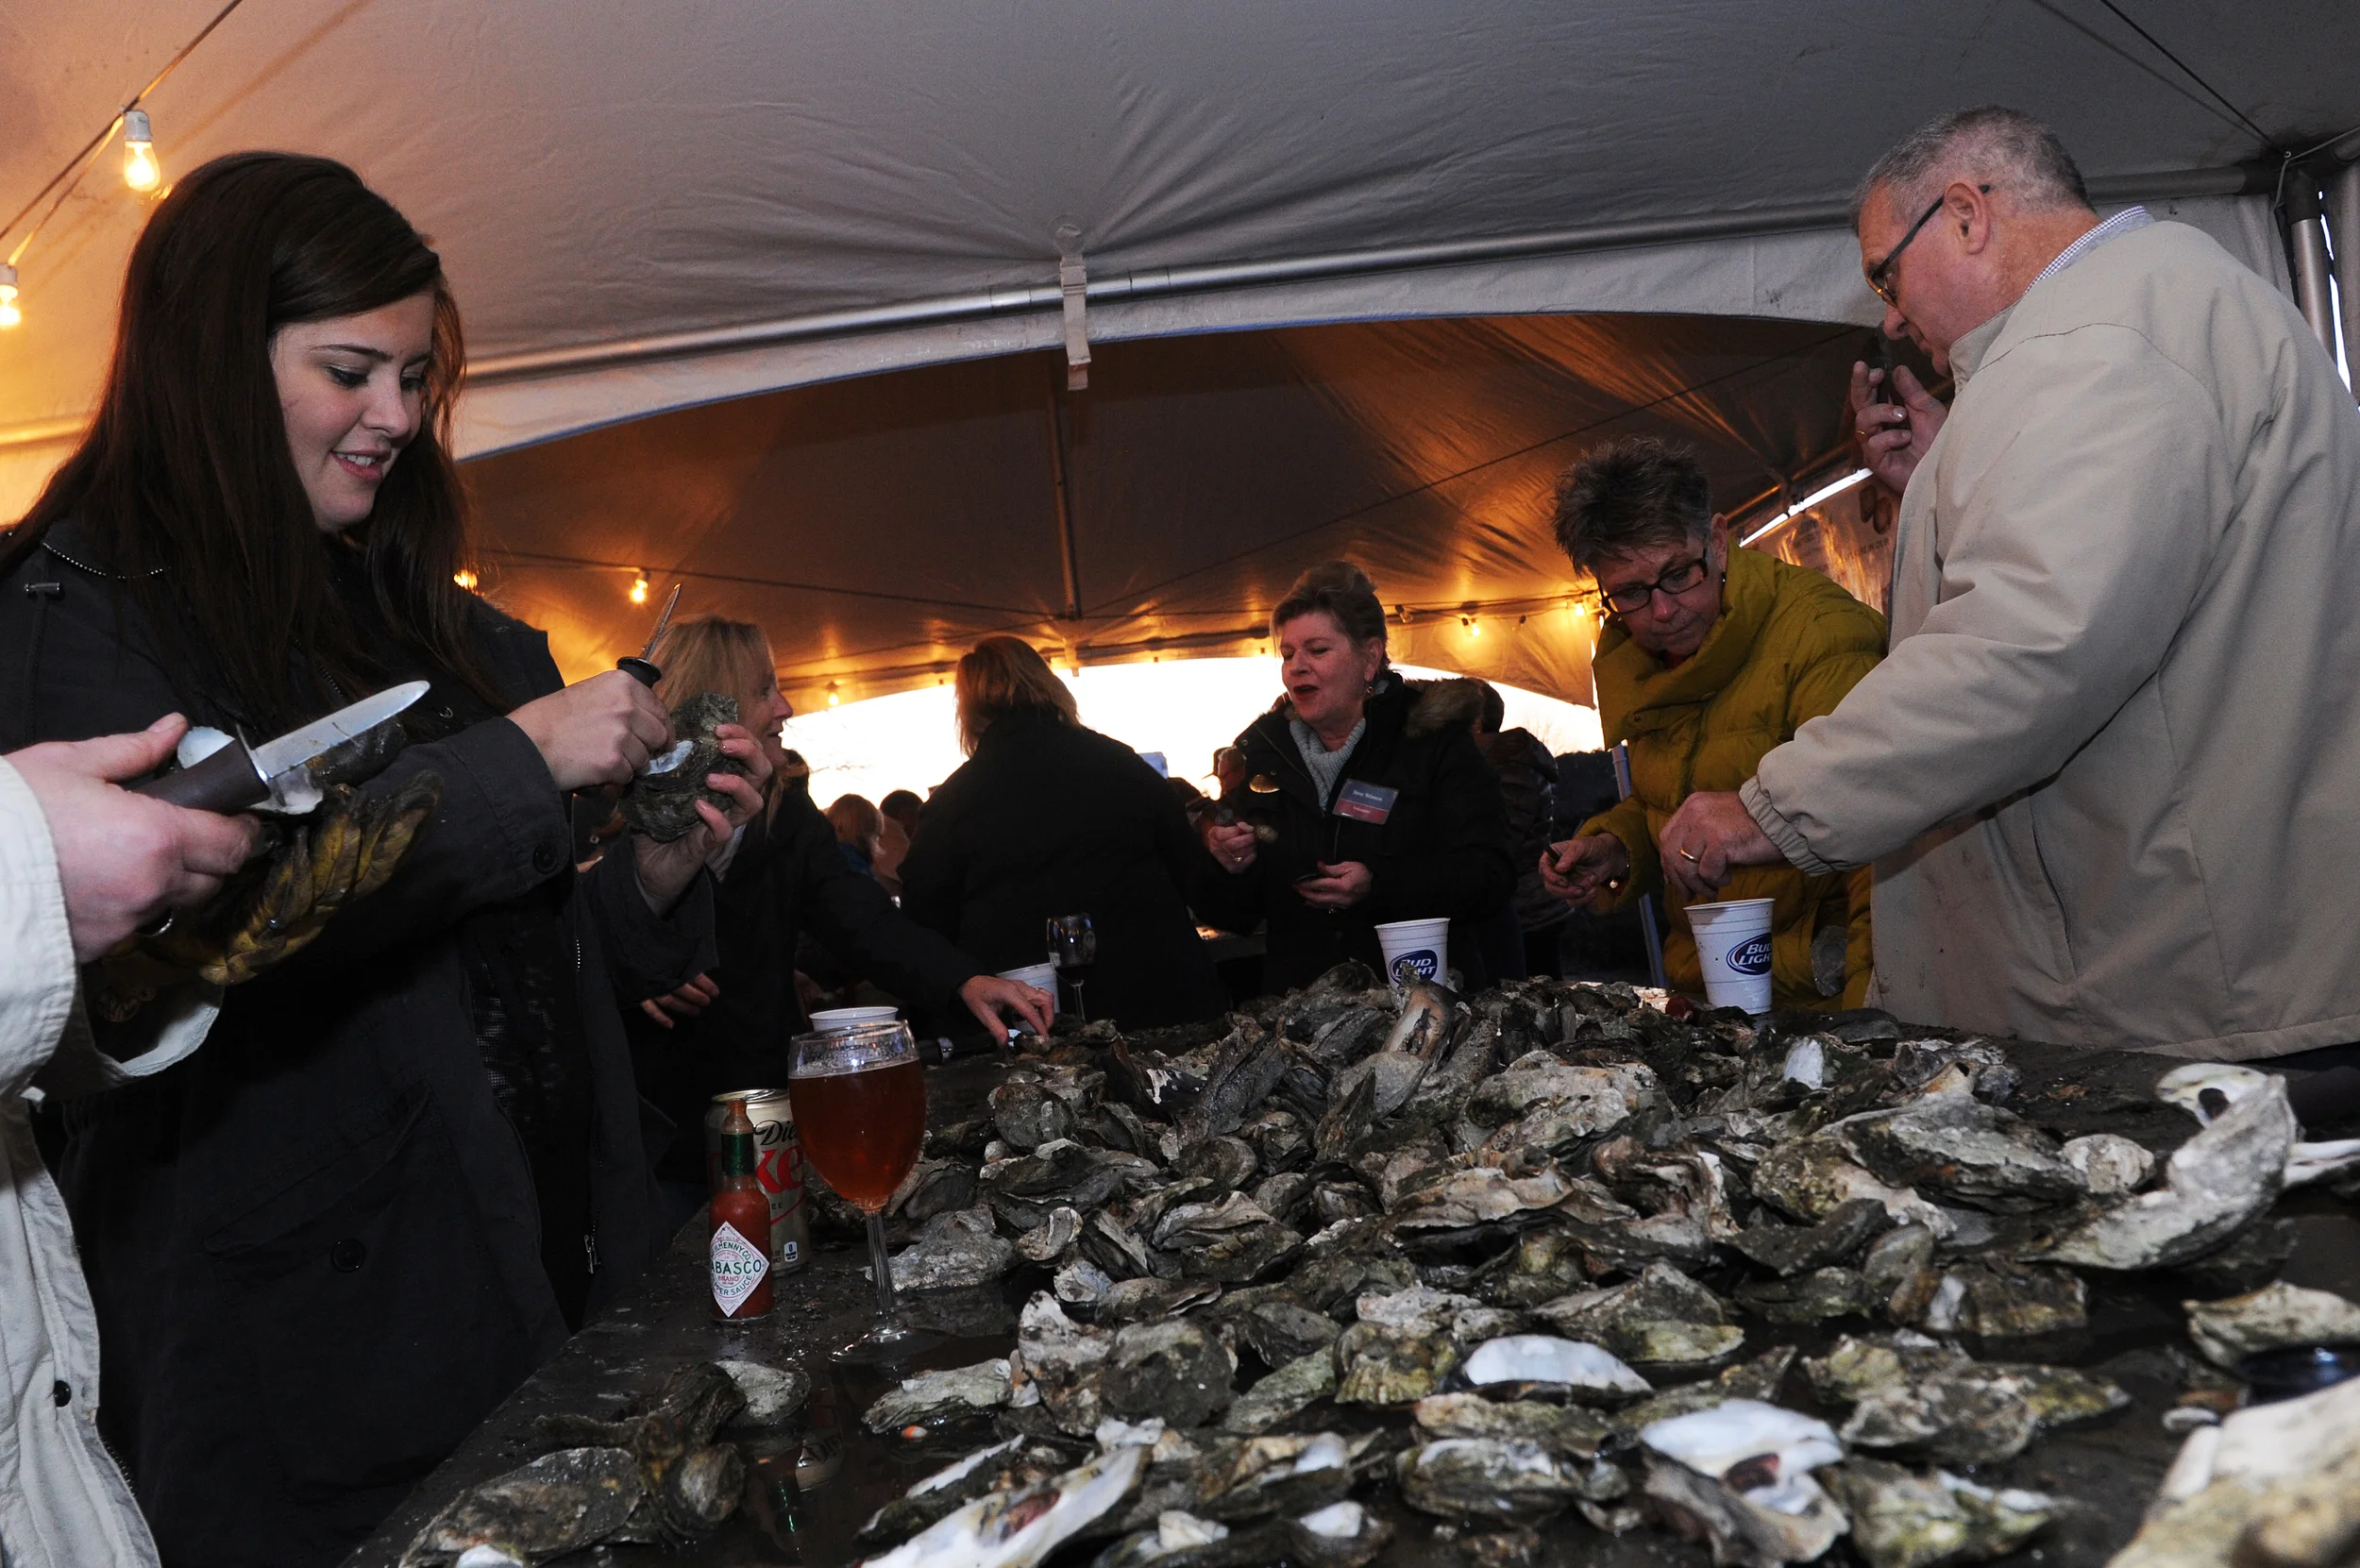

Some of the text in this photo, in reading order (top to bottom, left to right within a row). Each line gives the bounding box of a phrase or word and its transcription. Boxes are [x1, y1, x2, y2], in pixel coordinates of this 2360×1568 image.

[1738, 953, 1773, 966] LIGH
[1395, 966, 1436, 977] LHT
[753, 1120, 797, 1146] Die
[711, 1259, 762, 1274] ABASCO
[731, 1275, 751, 1295] SAUCE
